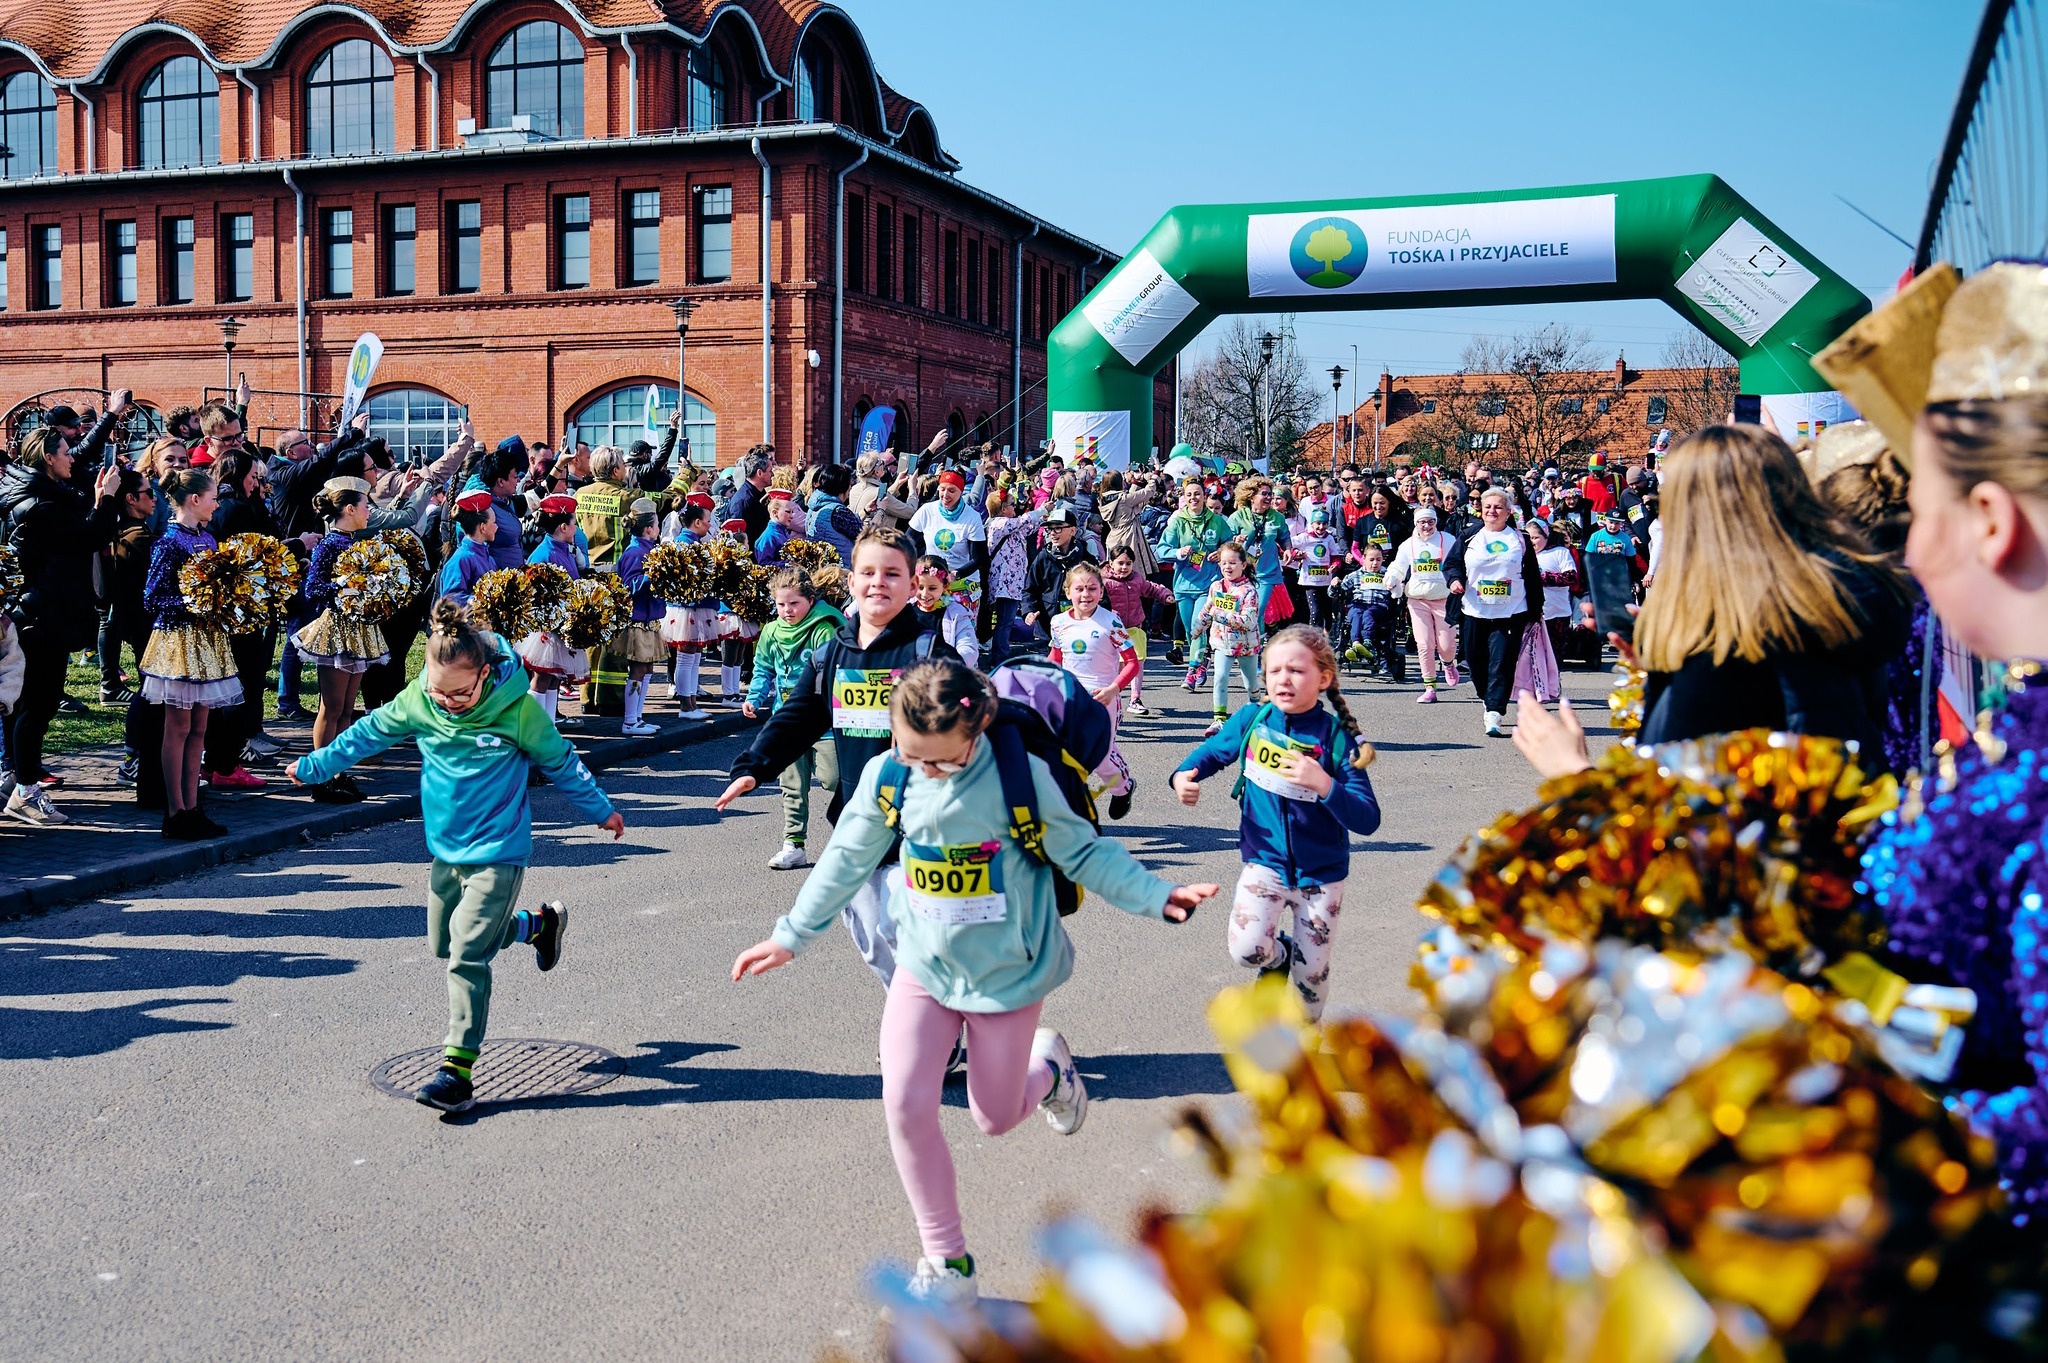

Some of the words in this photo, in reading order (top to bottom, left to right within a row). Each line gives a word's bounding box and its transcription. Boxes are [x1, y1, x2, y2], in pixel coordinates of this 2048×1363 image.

[1387, 228, 1472, 244] FUNDACJA
[1388, 247, 1445, 264] TOŚKA
[1450, 248, 1455, 262] I
[1460, 242, 1569, 262] PRZYJACIELE
[1716, 248, 1738, 268] CLEVER
[1737, 263, 1769, 292] SOLUTIONS
[1767, 287, 1789, 305] GROUP
[1694, 272, 1762, 328] systemy
[1708, 275, 1760, 317] PROFESJONALNE
[1417, 564, 1438, 572] 0476
[1482, 587, 1506, 596] 0523
[1215, 599, 1234, 610] 0263
[844, 688, 890, 707] 0376
[915, 867, 983, 893] 0907
